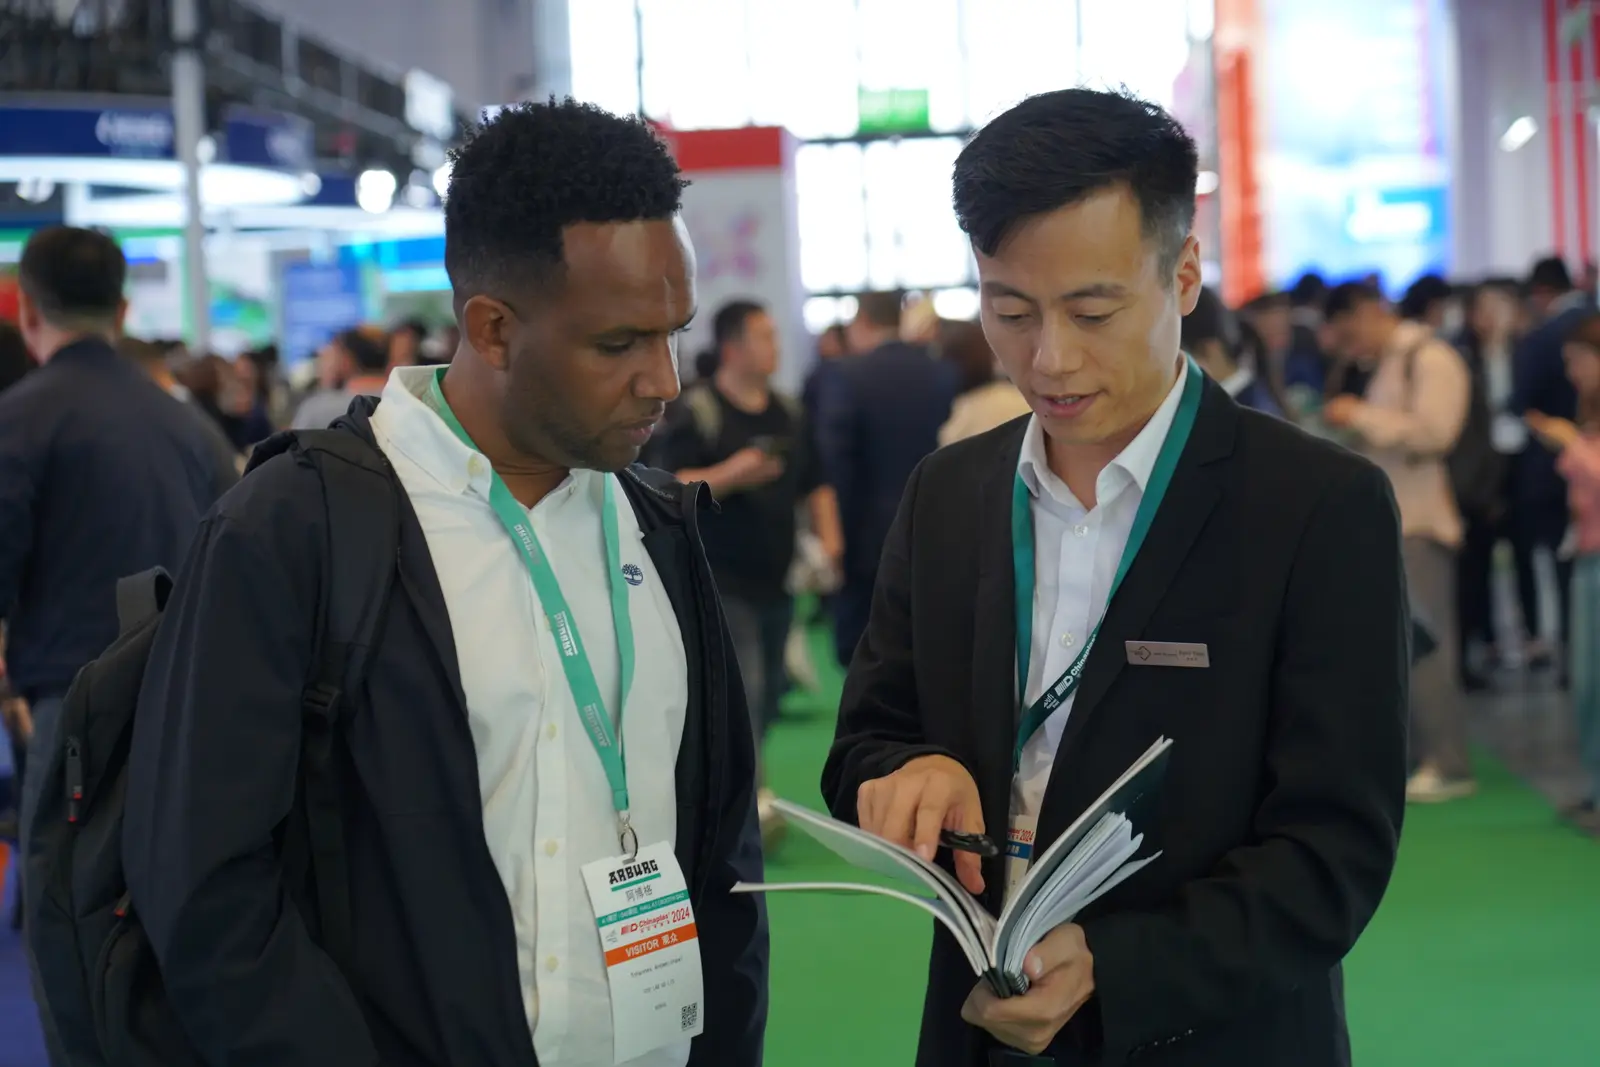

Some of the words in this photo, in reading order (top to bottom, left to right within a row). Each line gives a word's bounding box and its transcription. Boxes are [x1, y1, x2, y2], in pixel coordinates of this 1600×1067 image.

[553, 613, 574, 657] ARBURG
[608, 859, 659, 885] ARBURG
[671, 906, 690, 923] 2024
[625, 939, 660, 957] VISITOR
